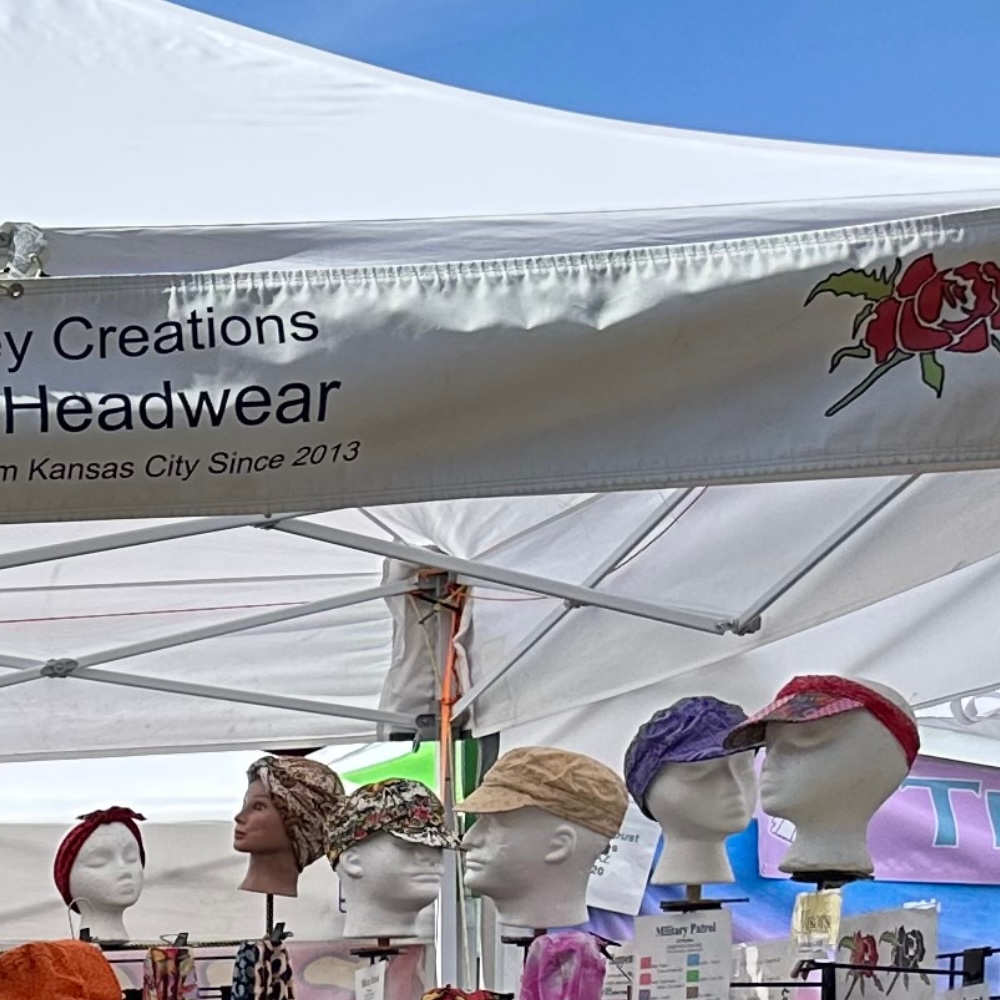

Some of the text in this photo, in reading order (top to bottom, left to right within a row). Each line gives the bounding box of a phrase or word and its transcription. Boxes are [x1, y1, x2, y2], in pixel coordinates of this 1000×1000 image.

[53, 307, 319, 361] Creations
[3, 380, 341, 434] Headwear
[28, 457, 134, 482] Kansas
[145, 453, 200, 481] City
[207, 451, 285, 475] Since
[291, 440, 361, 467] 2013
[690, 922, 717, 935] Patrol
